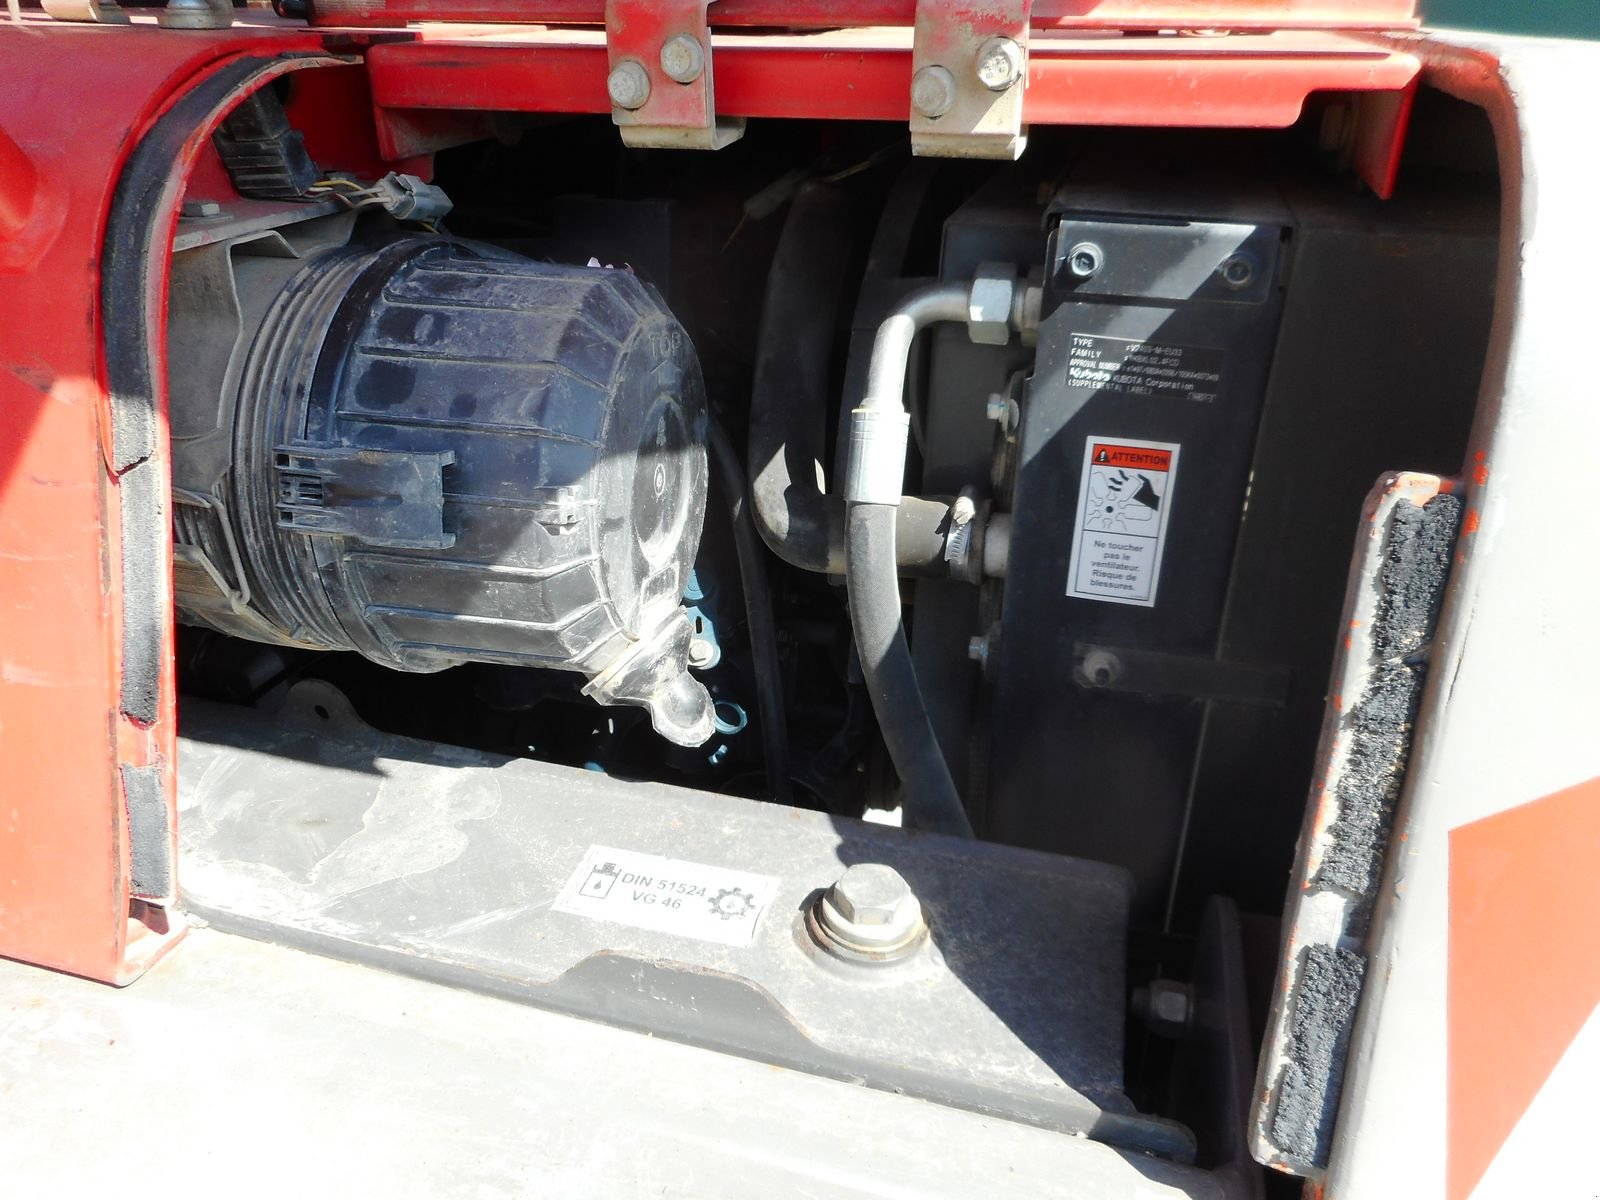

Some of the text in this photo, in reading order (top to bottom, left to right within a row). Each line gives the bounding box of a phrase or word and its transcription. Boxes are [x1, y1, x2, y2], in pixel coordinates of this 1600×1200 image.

[649, 331, 681, 356] TOP
[1073, 337, 1093, 347] TYPE
[1070, 348, 1101, 359] FAMILY
[1070, 367, 1111, 382] Kubota
[1112, 374, 1142, 384] KUBOTA
[1145, 377, 1194, 391] Corporation
[1068, 379, 1152, 394] (SUPPLEMENTAL LABEL)
[1111, 451, 1168, 465] ATTENTION
[1094, 540, 1144, 552] Ne toucher
[1103, 552, 1131, 561] pas le
[1091, 561, 1141, 571] ventilateur.
[1092, 569, 1123, 580] Risque
[1090, 579, 1136, 590] blessures.
[621, 872, 707, 897] DIN 51524
[632, 890, 681, 910] VG 46
